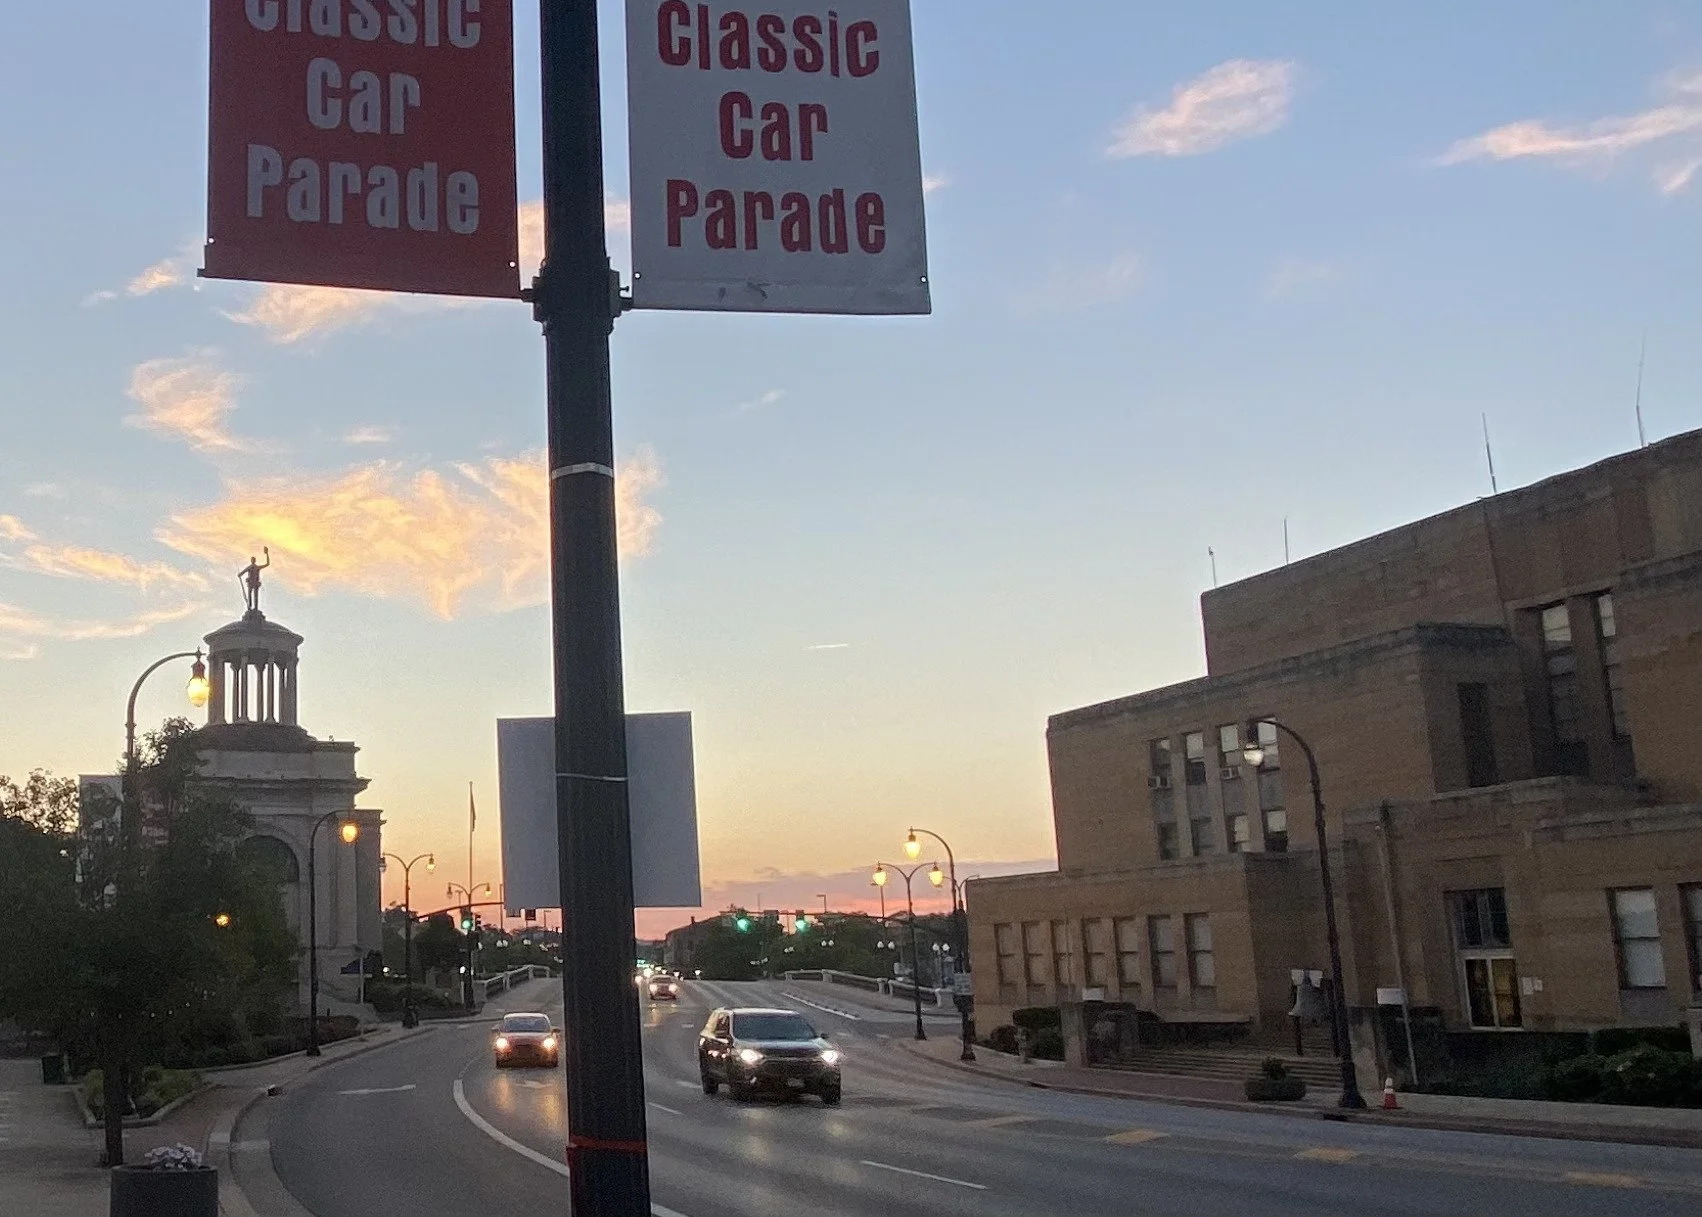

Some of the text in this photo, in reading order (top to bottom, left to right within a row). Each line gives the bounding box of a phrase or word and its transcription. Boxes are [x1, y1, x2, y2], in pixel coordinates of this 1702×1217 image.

[657, 0, 880, 78] Classic
[306, 57, 421, 135] Car
[719, 91, 828, 161] Car
[246, 143, 480, 234] Parade
[666, 179, 886, 254] Parade
